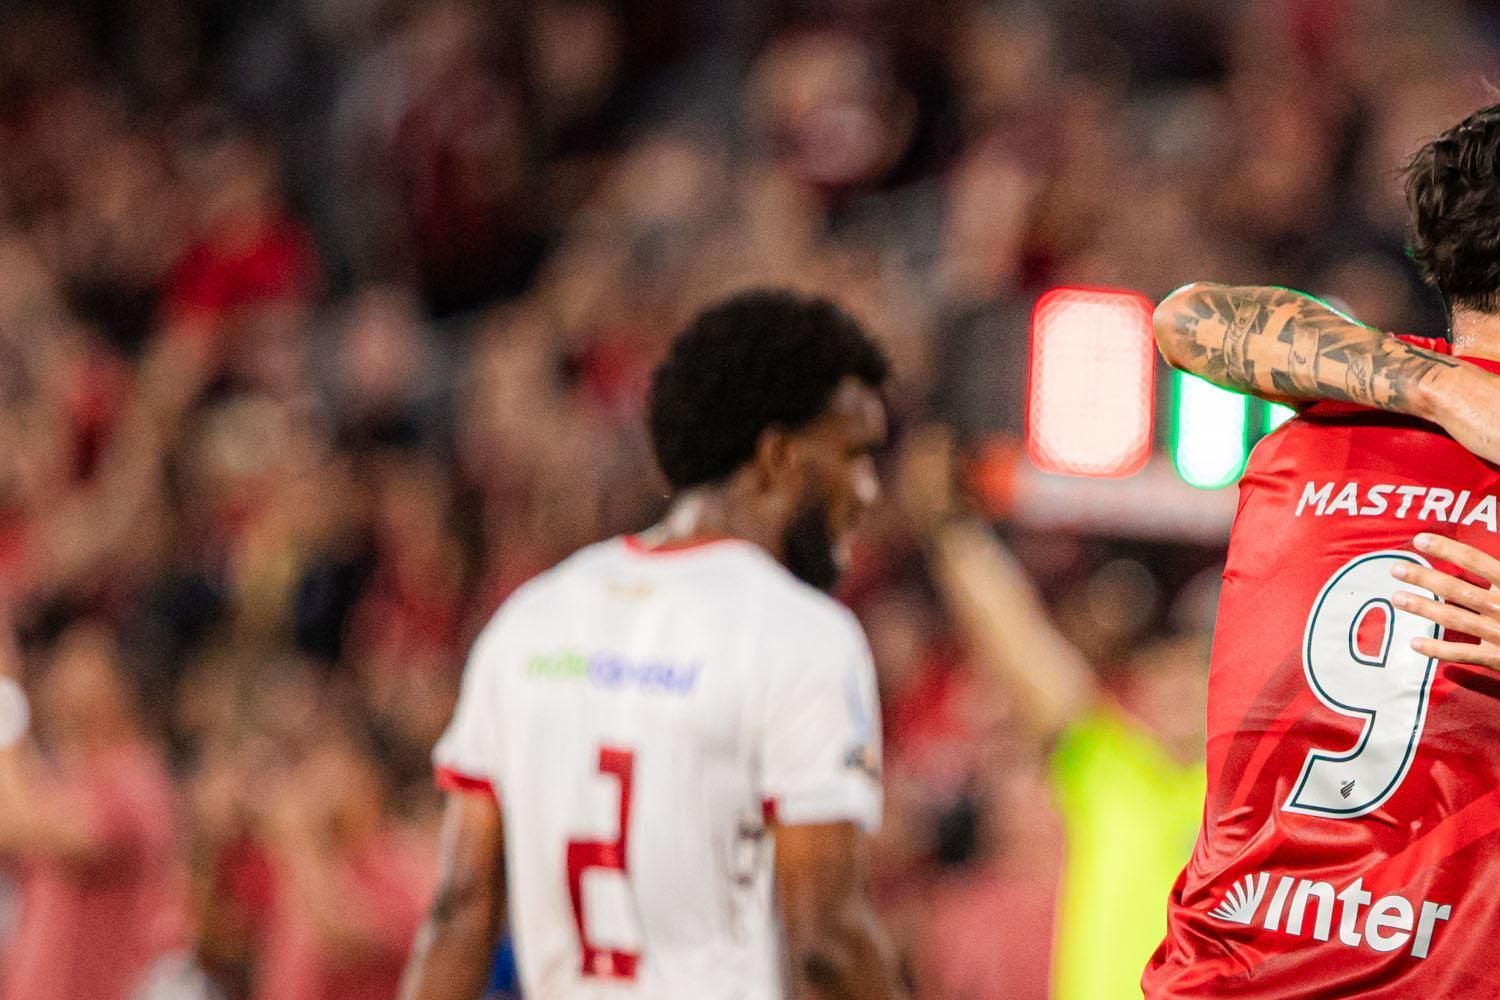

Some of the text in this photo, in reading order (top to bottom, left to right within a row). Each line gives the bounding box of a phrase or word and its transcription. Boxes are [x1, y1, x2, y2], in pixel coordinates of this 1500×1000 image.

[1281, 550, 1445, 819] 9
[566, 746, 641, 982] 2
[1263, 876, 1452, 959] inter
